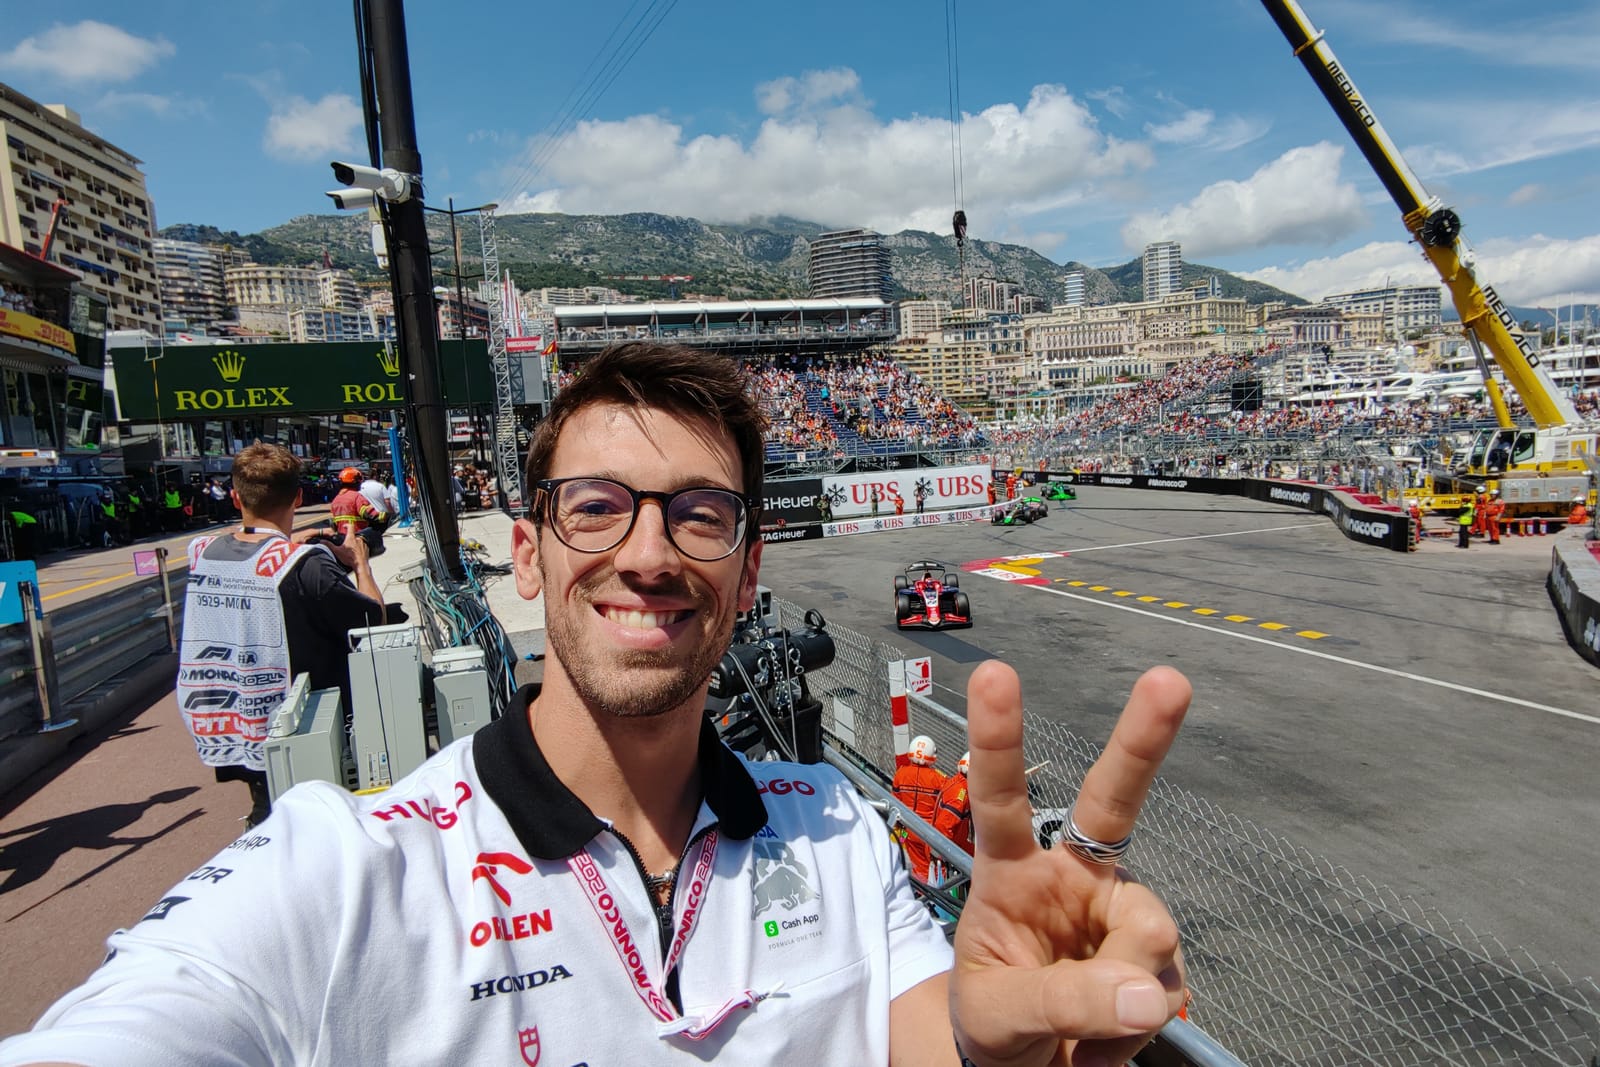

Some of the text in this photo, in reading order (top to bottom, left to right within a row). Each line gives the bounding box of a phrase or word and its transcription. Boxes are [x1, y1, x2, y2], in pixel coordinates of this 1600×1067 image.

[174, 387, 293, 410] ROLEX
[341, 383, 404, 403] ROL
[850, 481, 900, 504] UBS
[936, 474, 984, 497] UBS
[883, 517, 904, 529] UBS
[921, 513, 941, 525] UBS
[955, 510, 973, 521] UBS
[838, 523, 859, 534] UBS
[188, 668, 239, 683] MONAC
[193, 717, 231, 732] PIT
[756, 779, 815, 795] GO
[574, 849, 607, 896] 202
[782, 918, 801, 929] Cash
[803, 914, 819, 924] App
[470, 964, 573, 1001] HONDA
